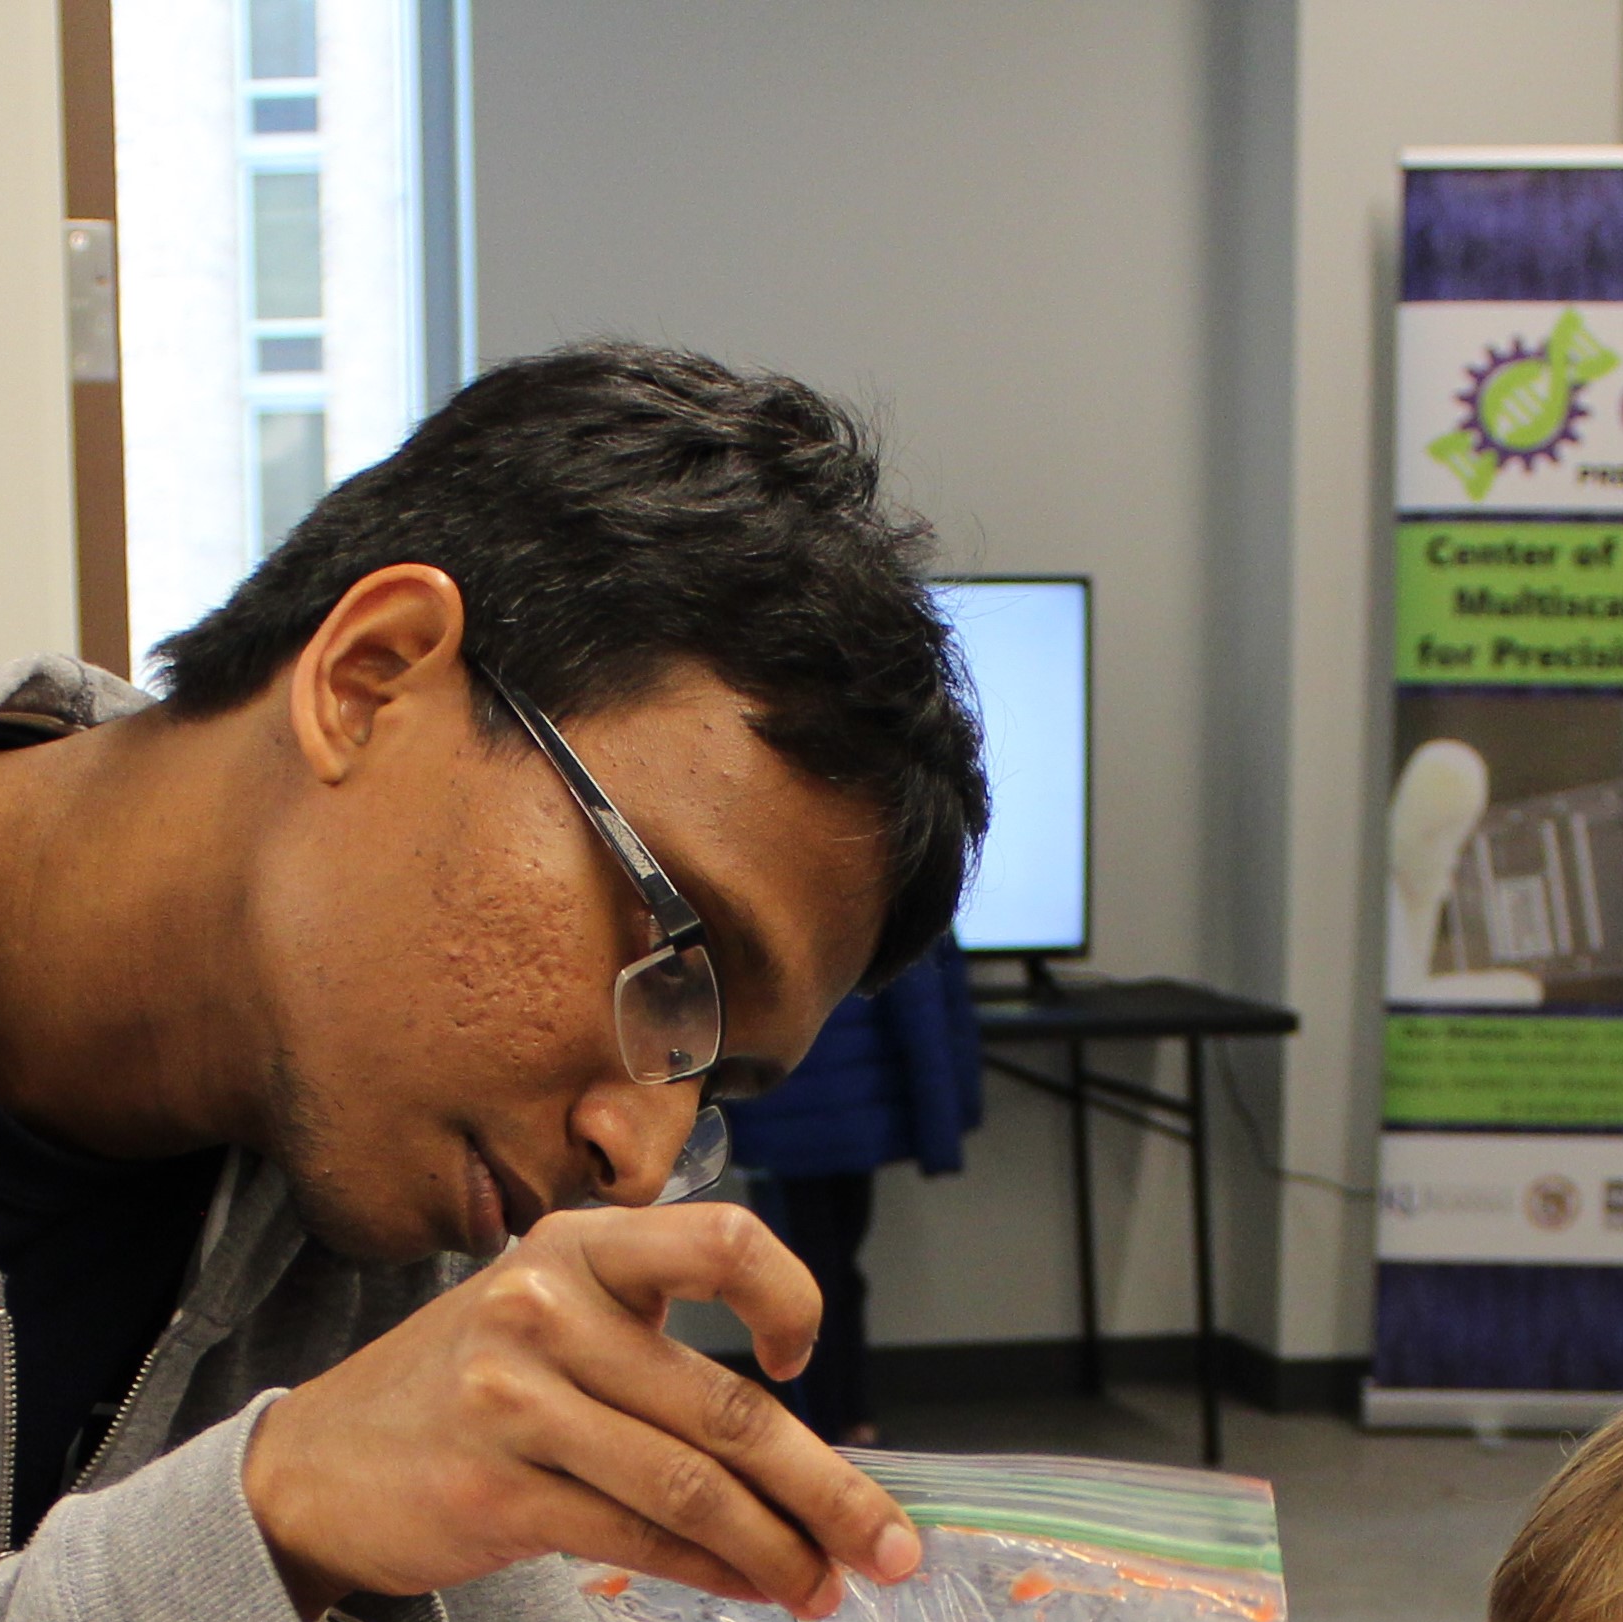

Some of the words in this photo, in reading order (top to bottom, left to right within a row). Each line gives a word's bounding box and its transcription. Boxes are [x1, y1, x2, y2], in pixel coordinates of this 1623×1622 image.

[1425, 535, 1558, 569] Center
[1572, 535, 1615, 568] of
[1417, 636, 1477, 668] for
